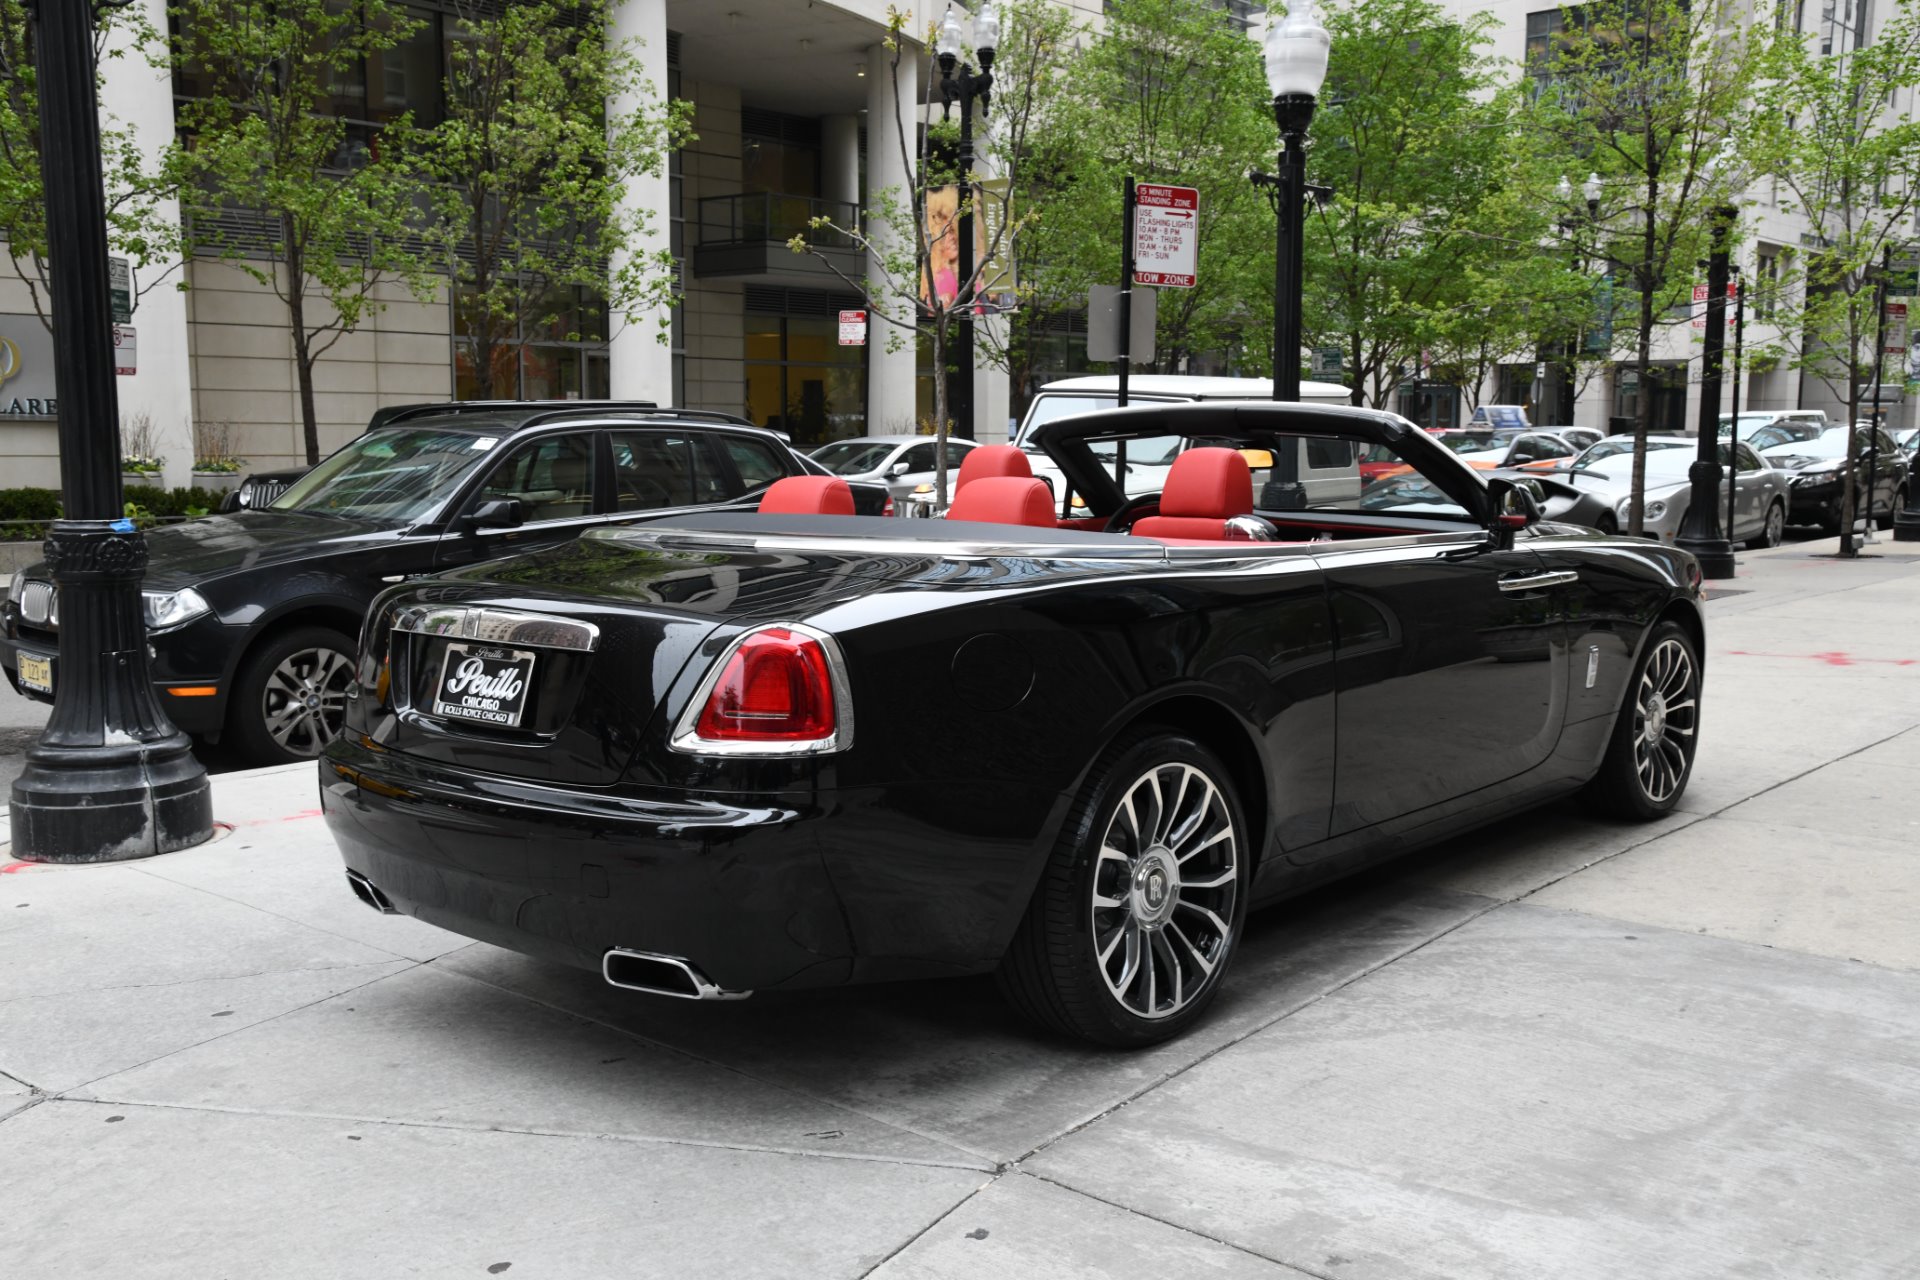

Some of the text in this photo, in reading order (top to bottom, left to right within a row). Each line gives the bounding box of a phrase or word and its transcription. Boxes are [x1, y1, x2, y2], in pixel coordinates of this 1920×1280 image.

[1148, 188, 1173, 198] MINUTE
[1140, 195, 1192, 208] STANDING ZONE
[1139, 209, 1153, 217] USE
[1139, 217, 1194, 229] FLASHING LIGHTS
[1169, 228, 1180, 236] PM
[1138, 234, 1154, 242] MON
[1160, 235, 1183, 244] THURS
[1138, 242, 1146, 250] 10
[1138, 250, 1150, 258] FRI
[1155, 251, 1170, 260] SUN
[1138, 272, 1191, 285] TOW ZONE
[446, 657, 522, 701] Perillo
[461, 695, 500, 711] CHICAGO
[444, 705, 507, 722] ROLLS ROYCE CHICAGO
